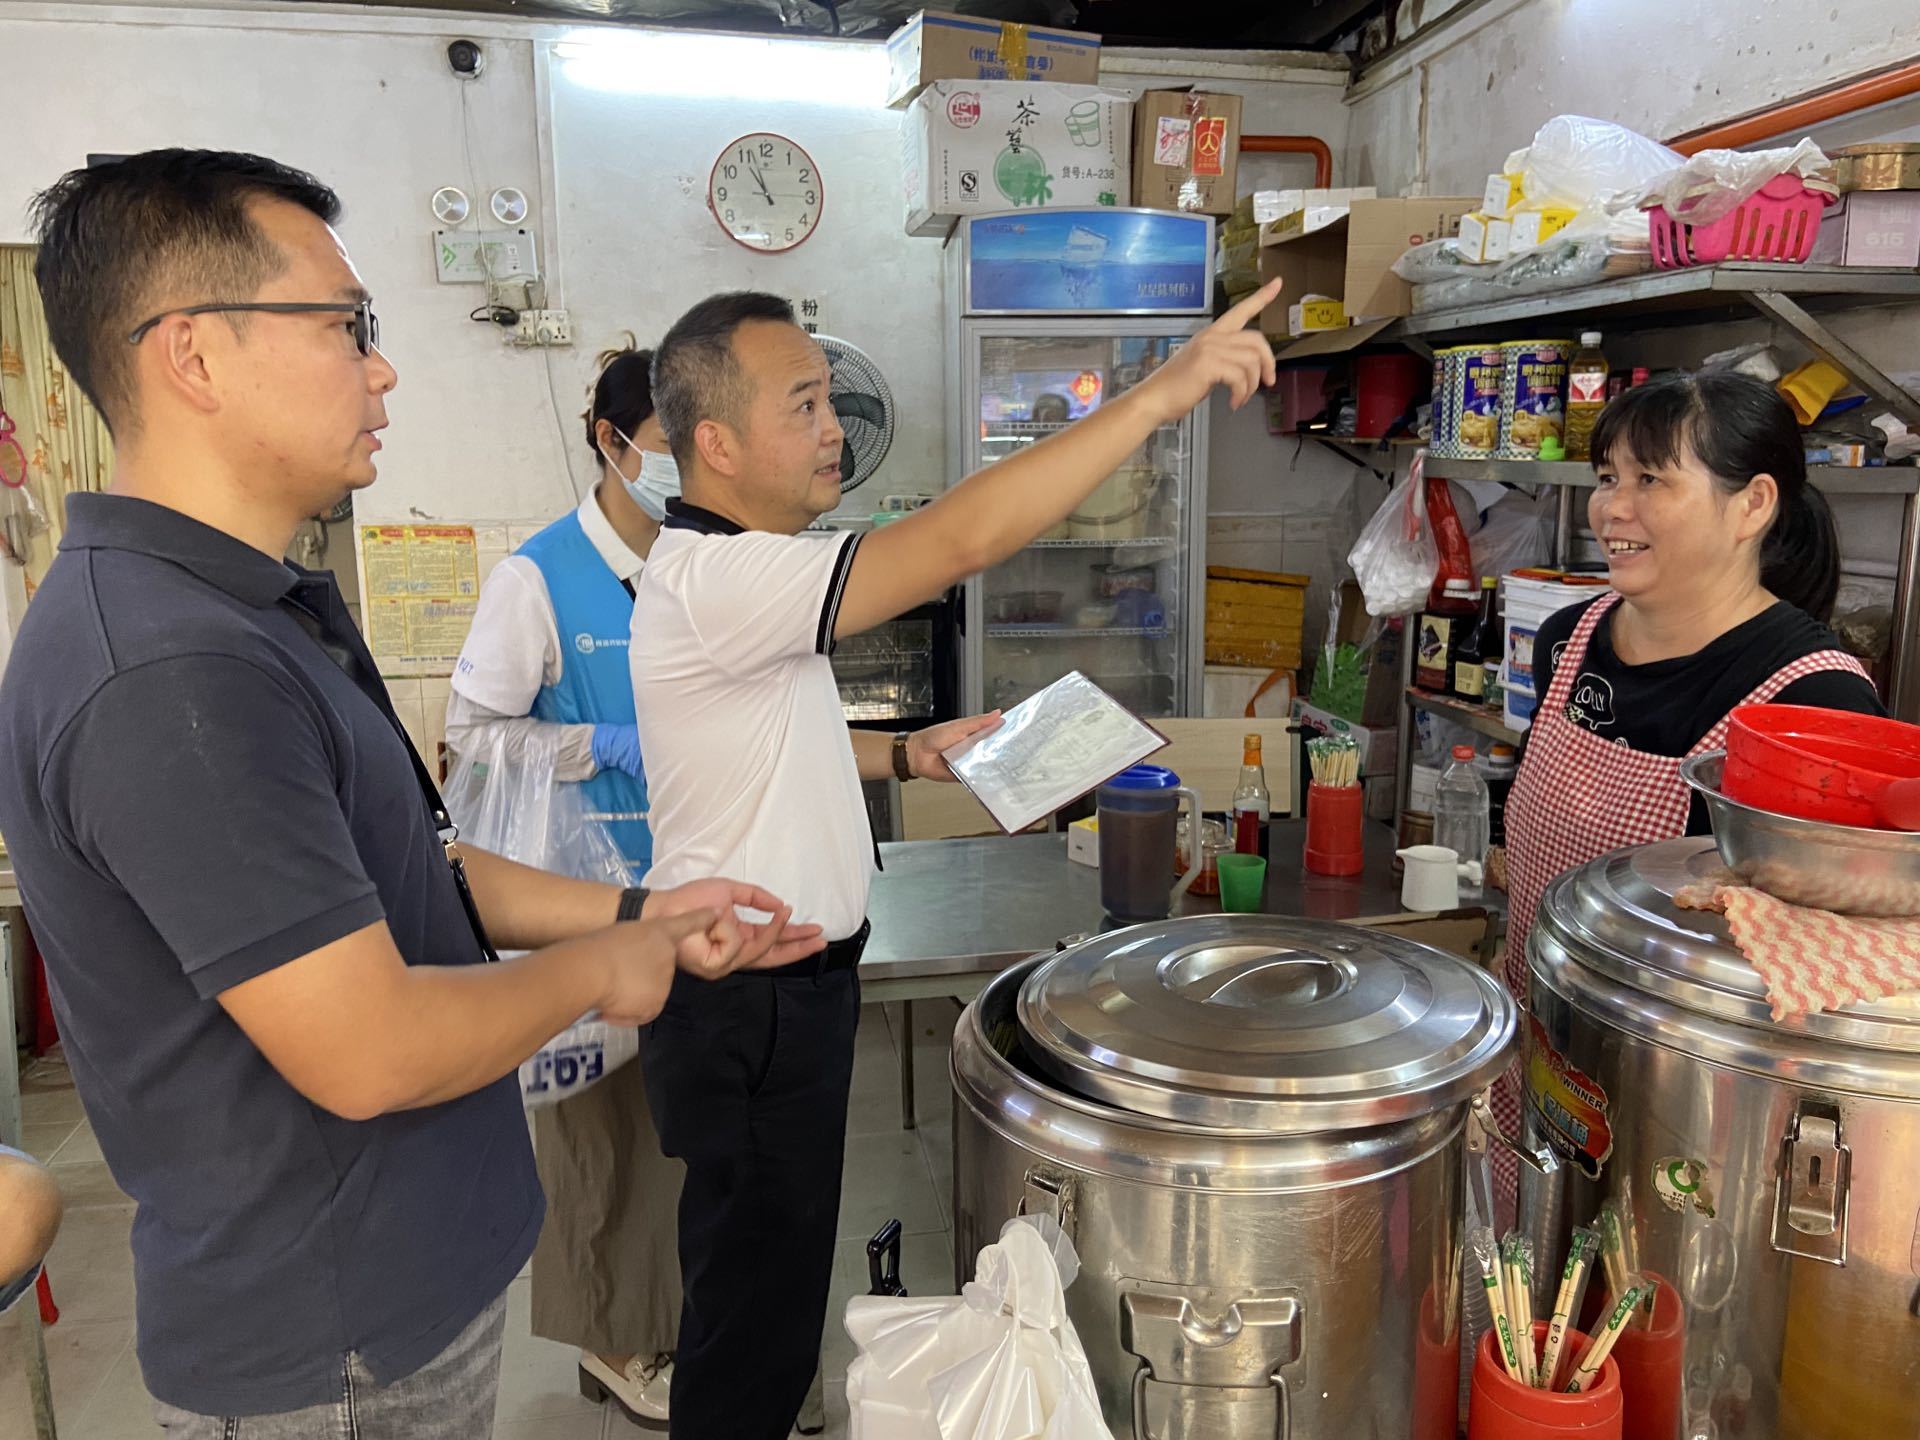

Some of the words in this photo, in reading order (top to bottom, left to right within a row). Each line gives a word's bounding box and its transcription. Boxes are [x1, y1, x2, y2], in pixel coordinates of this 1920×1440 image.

[739, 149, 751, 163] 11
[759, 143, 773, 158] 12
[786, 151, 792, 166] 1
[724, 165, 737, 179] 10
[799, 169, 809, 183] 2
[717, 187, 727, 201] 9
[805, 190, 815, 205] 3
[725, 209, 735, 223] 8
[798, 213, 808, 227] 4
[785, 228, 794, 241] 5
[1562, 1075, 1603, 1110] WINNER
